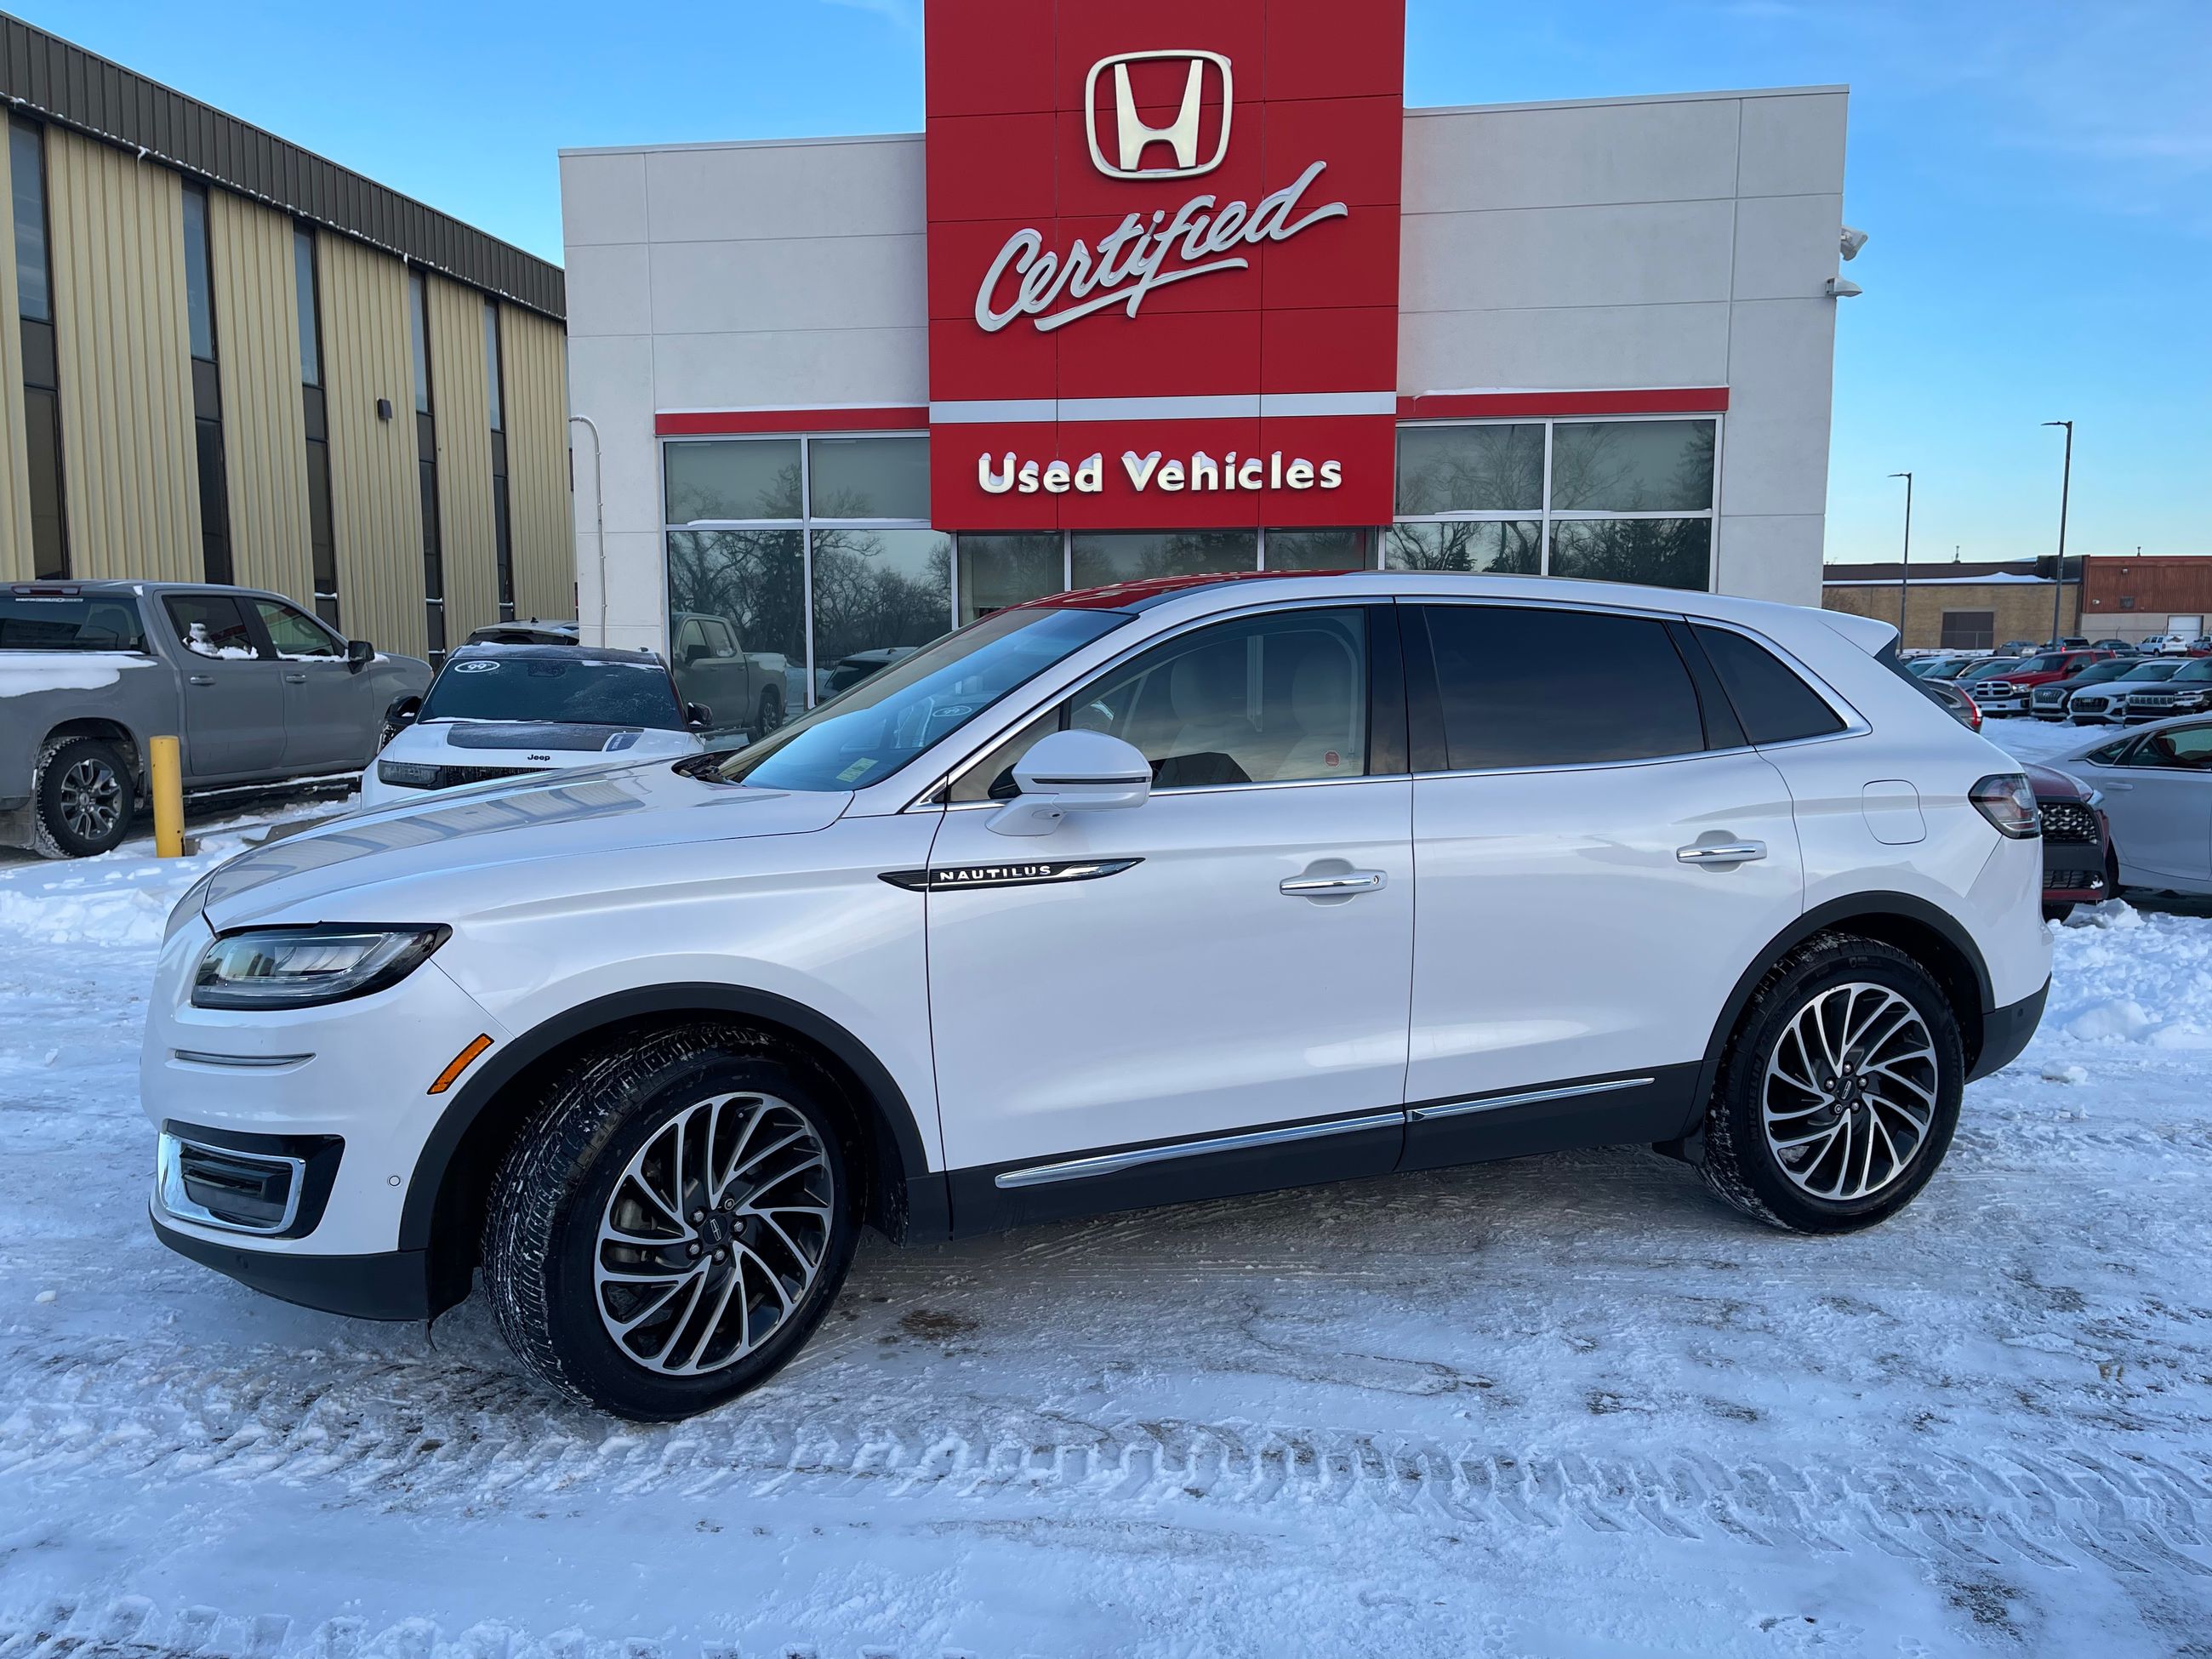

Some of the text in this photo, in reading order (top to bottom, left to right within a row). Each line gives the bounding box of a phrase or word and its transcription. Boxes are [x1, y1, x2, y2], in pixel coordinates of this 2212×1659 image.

[975, 161, 1348, 332] Certified
[978, 451, 1343, 493] Used Vehicles
[939, 865, 1051, 881] NAUTILUS
